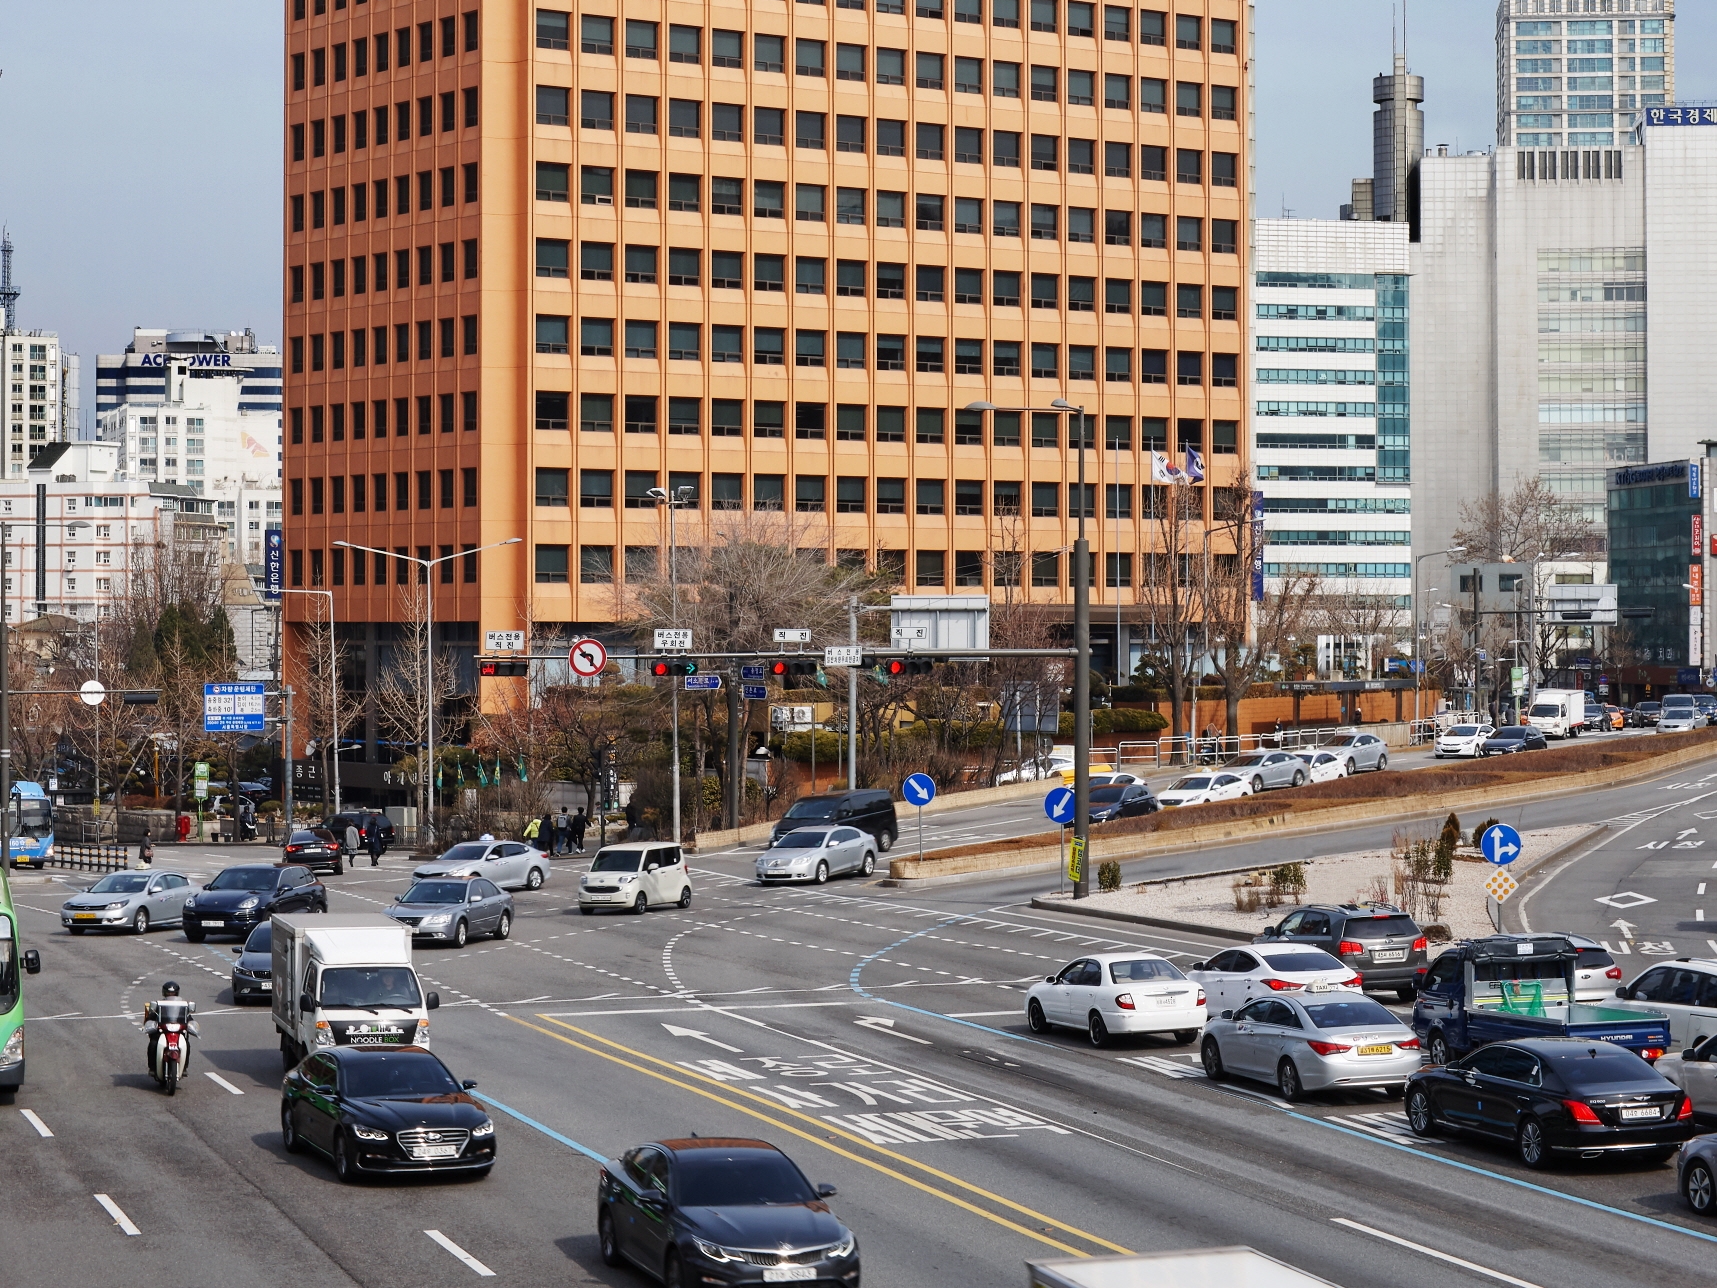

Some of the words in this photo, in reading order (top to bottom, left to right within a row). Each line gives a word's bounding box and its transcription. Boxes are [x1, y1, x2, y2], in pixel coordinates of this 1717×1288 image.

[1650, 108, 1717, 124] 한국경제
[270, 550, 280, 594] 신한은행
[488, 633, 521, 641] 버스전용
[657, 631, 689, 639] 버스전용
[495, 641, 514, 649] 직진
[1635, 840, 1706, 850] 시청
[676, 1054, 893, 1080] 세종로
[748, 1079, 977, 1108] 사거리
